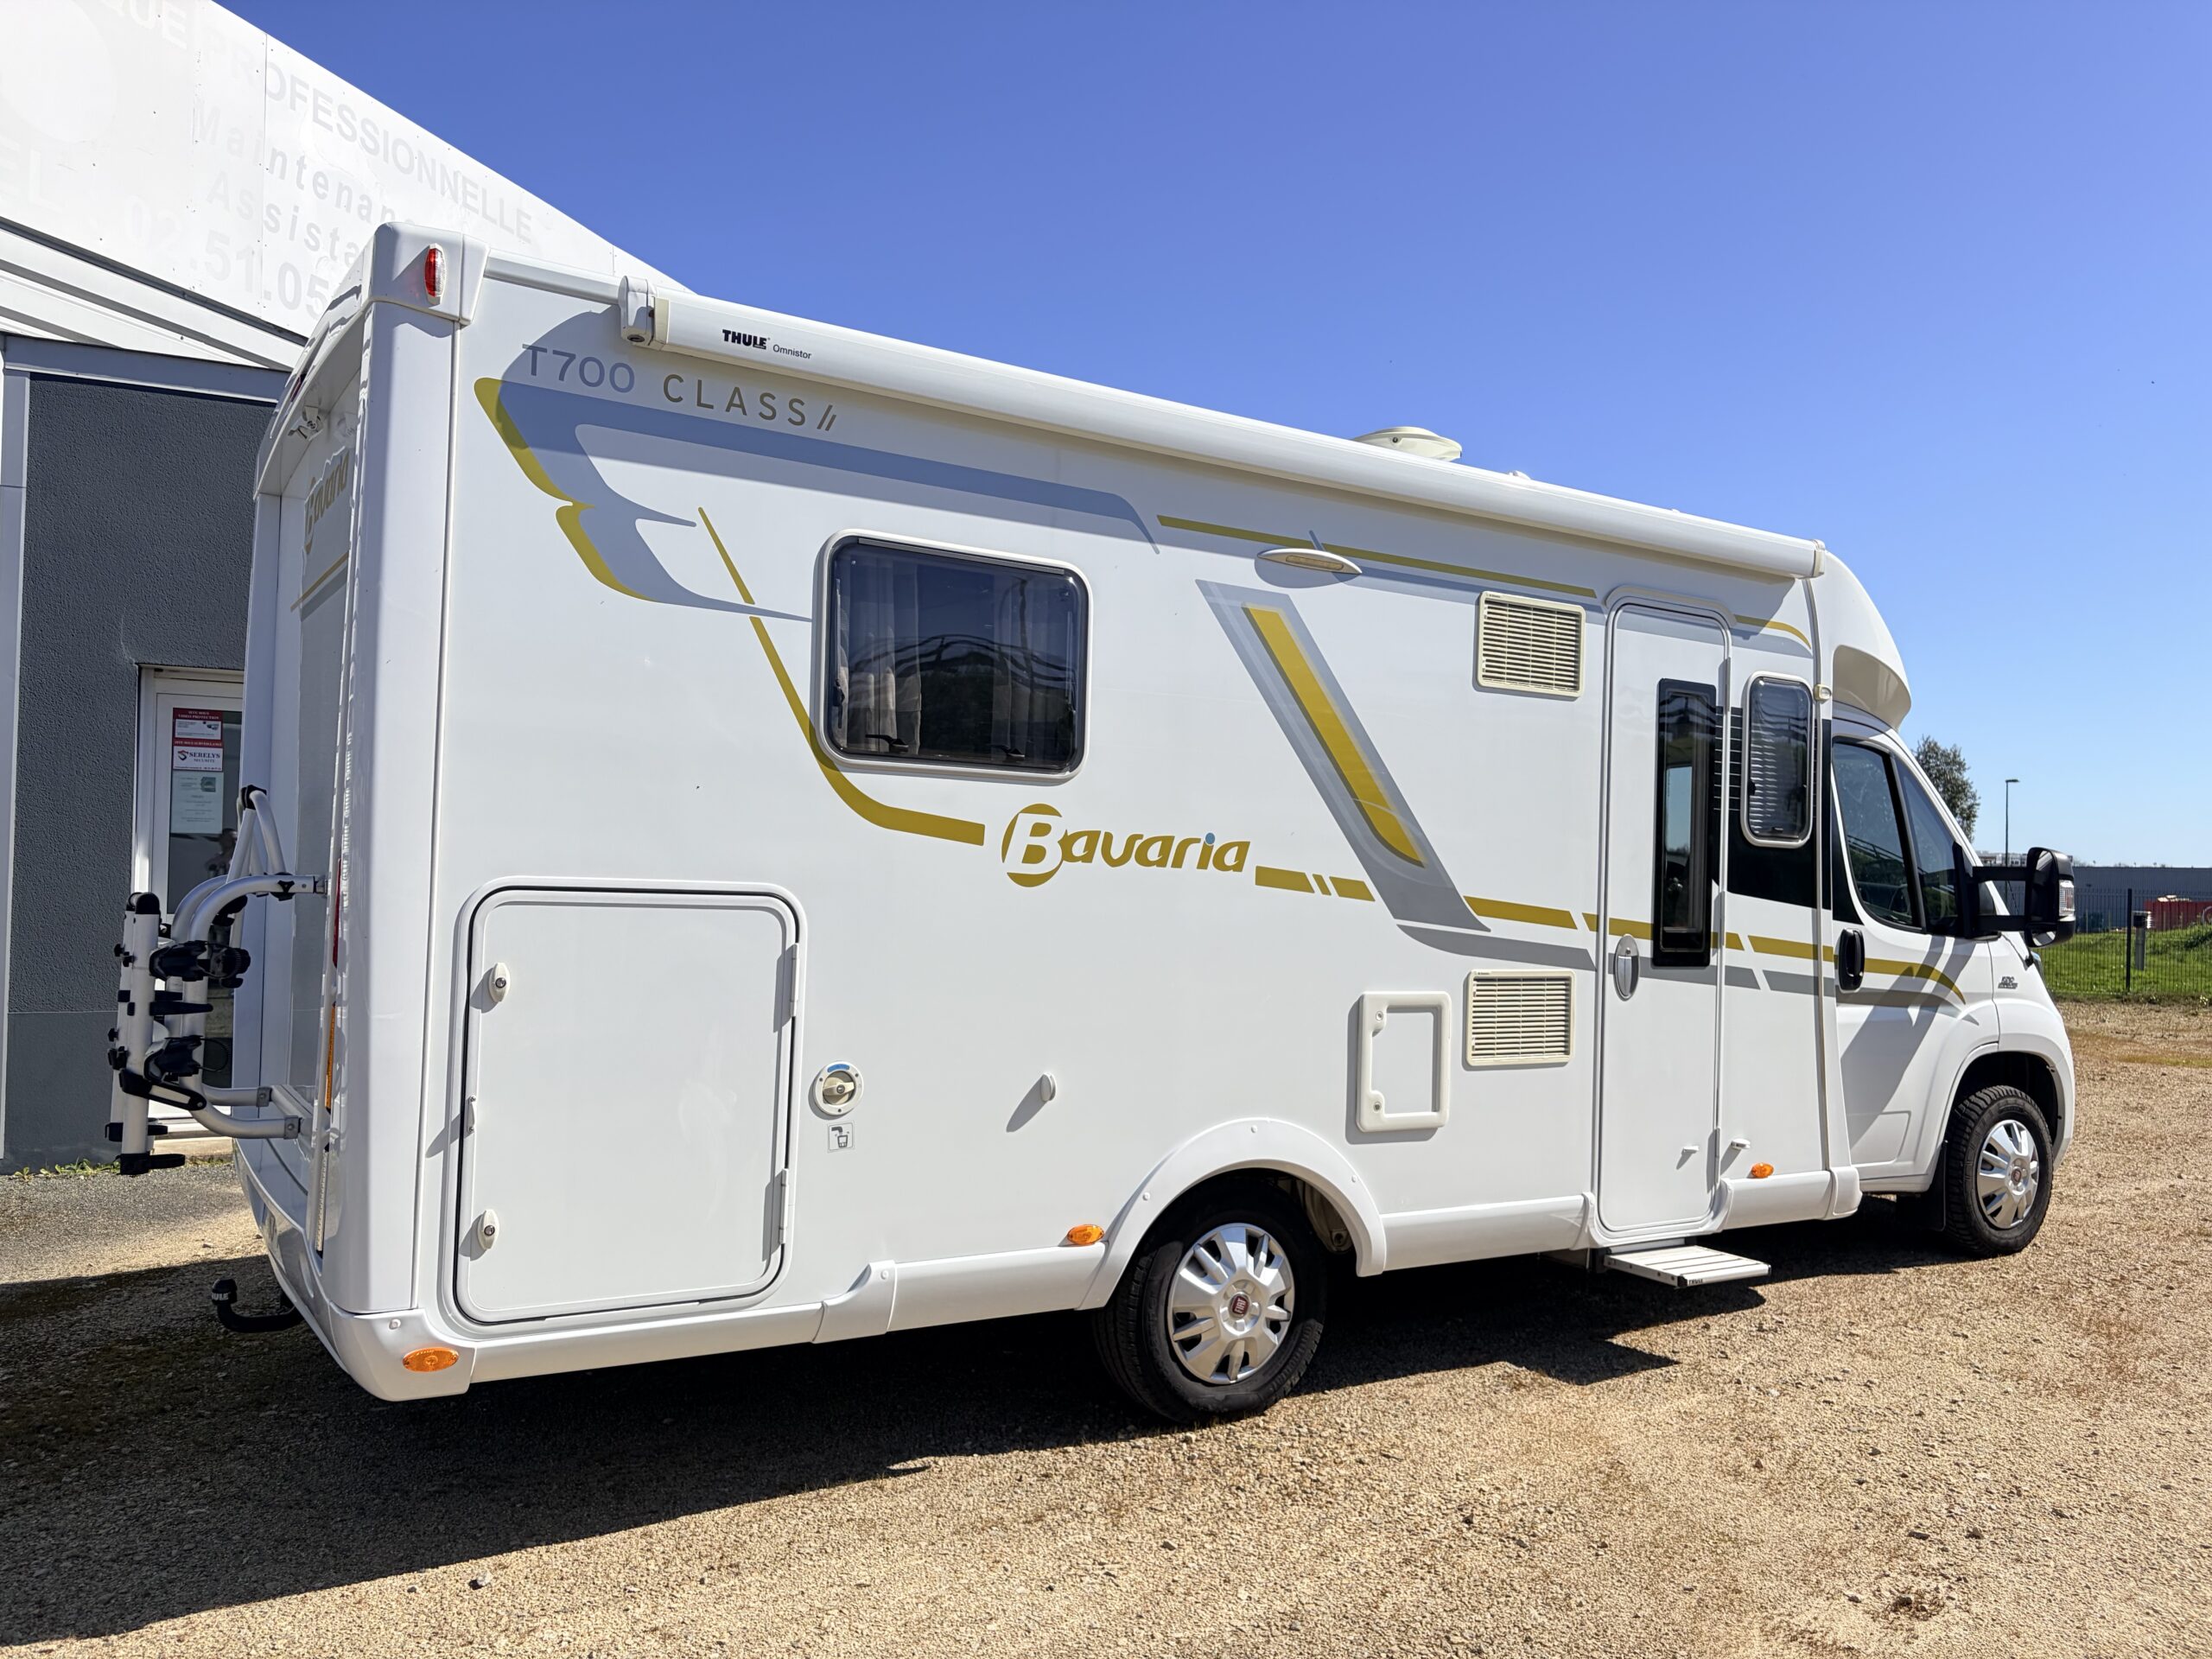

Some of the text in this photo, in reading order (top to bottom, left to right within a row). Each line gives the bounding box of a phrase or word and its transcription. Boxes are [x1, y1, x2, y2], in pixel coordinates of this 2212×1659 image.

[193, 98, 415, 225] Maintenan
[206, 25, 533, 244] PROFESSIONNELLE
[522, 344, 635, 393] T700
[663, 373, 806, 427] CLASS
[722, 329, 812, 359] THULE Omnistor
[1001, 803, 1251, 888] Bavaria
[1234, 1297, 1247, 1313] FIAT
